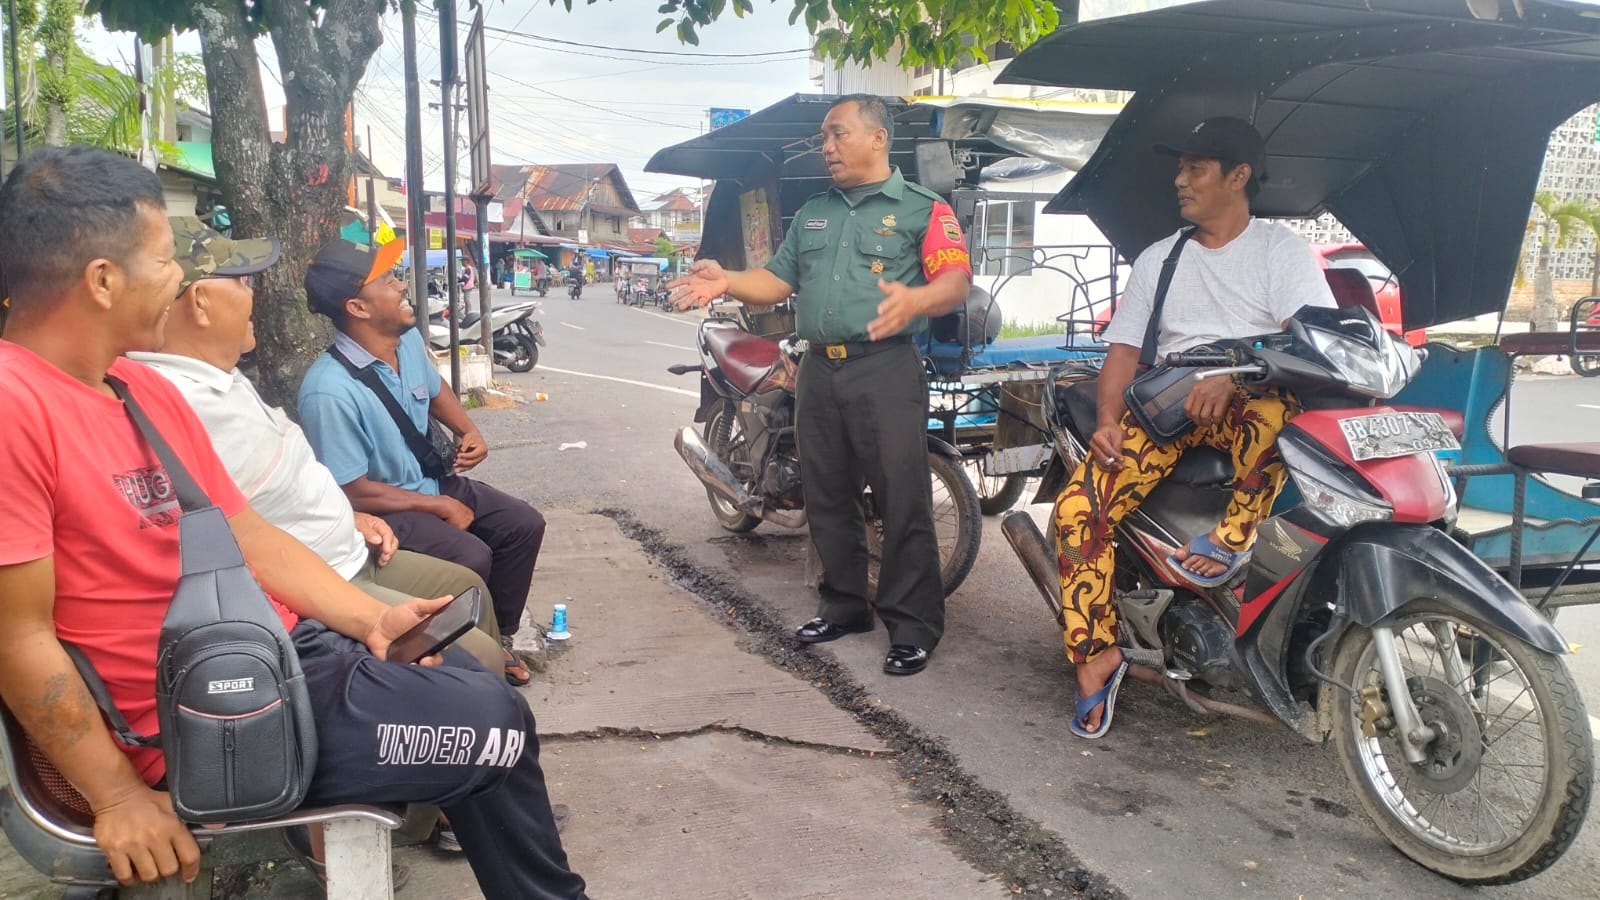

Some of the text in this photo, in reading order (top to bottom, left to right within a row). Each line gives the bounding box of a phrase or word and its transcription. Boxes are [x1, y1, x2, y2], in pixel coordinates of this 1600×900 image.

[1342, 419, 1368, 441] BB
[1369, 414, 1412, 438] 4307
[377, 723, 476, 766] UNDER
